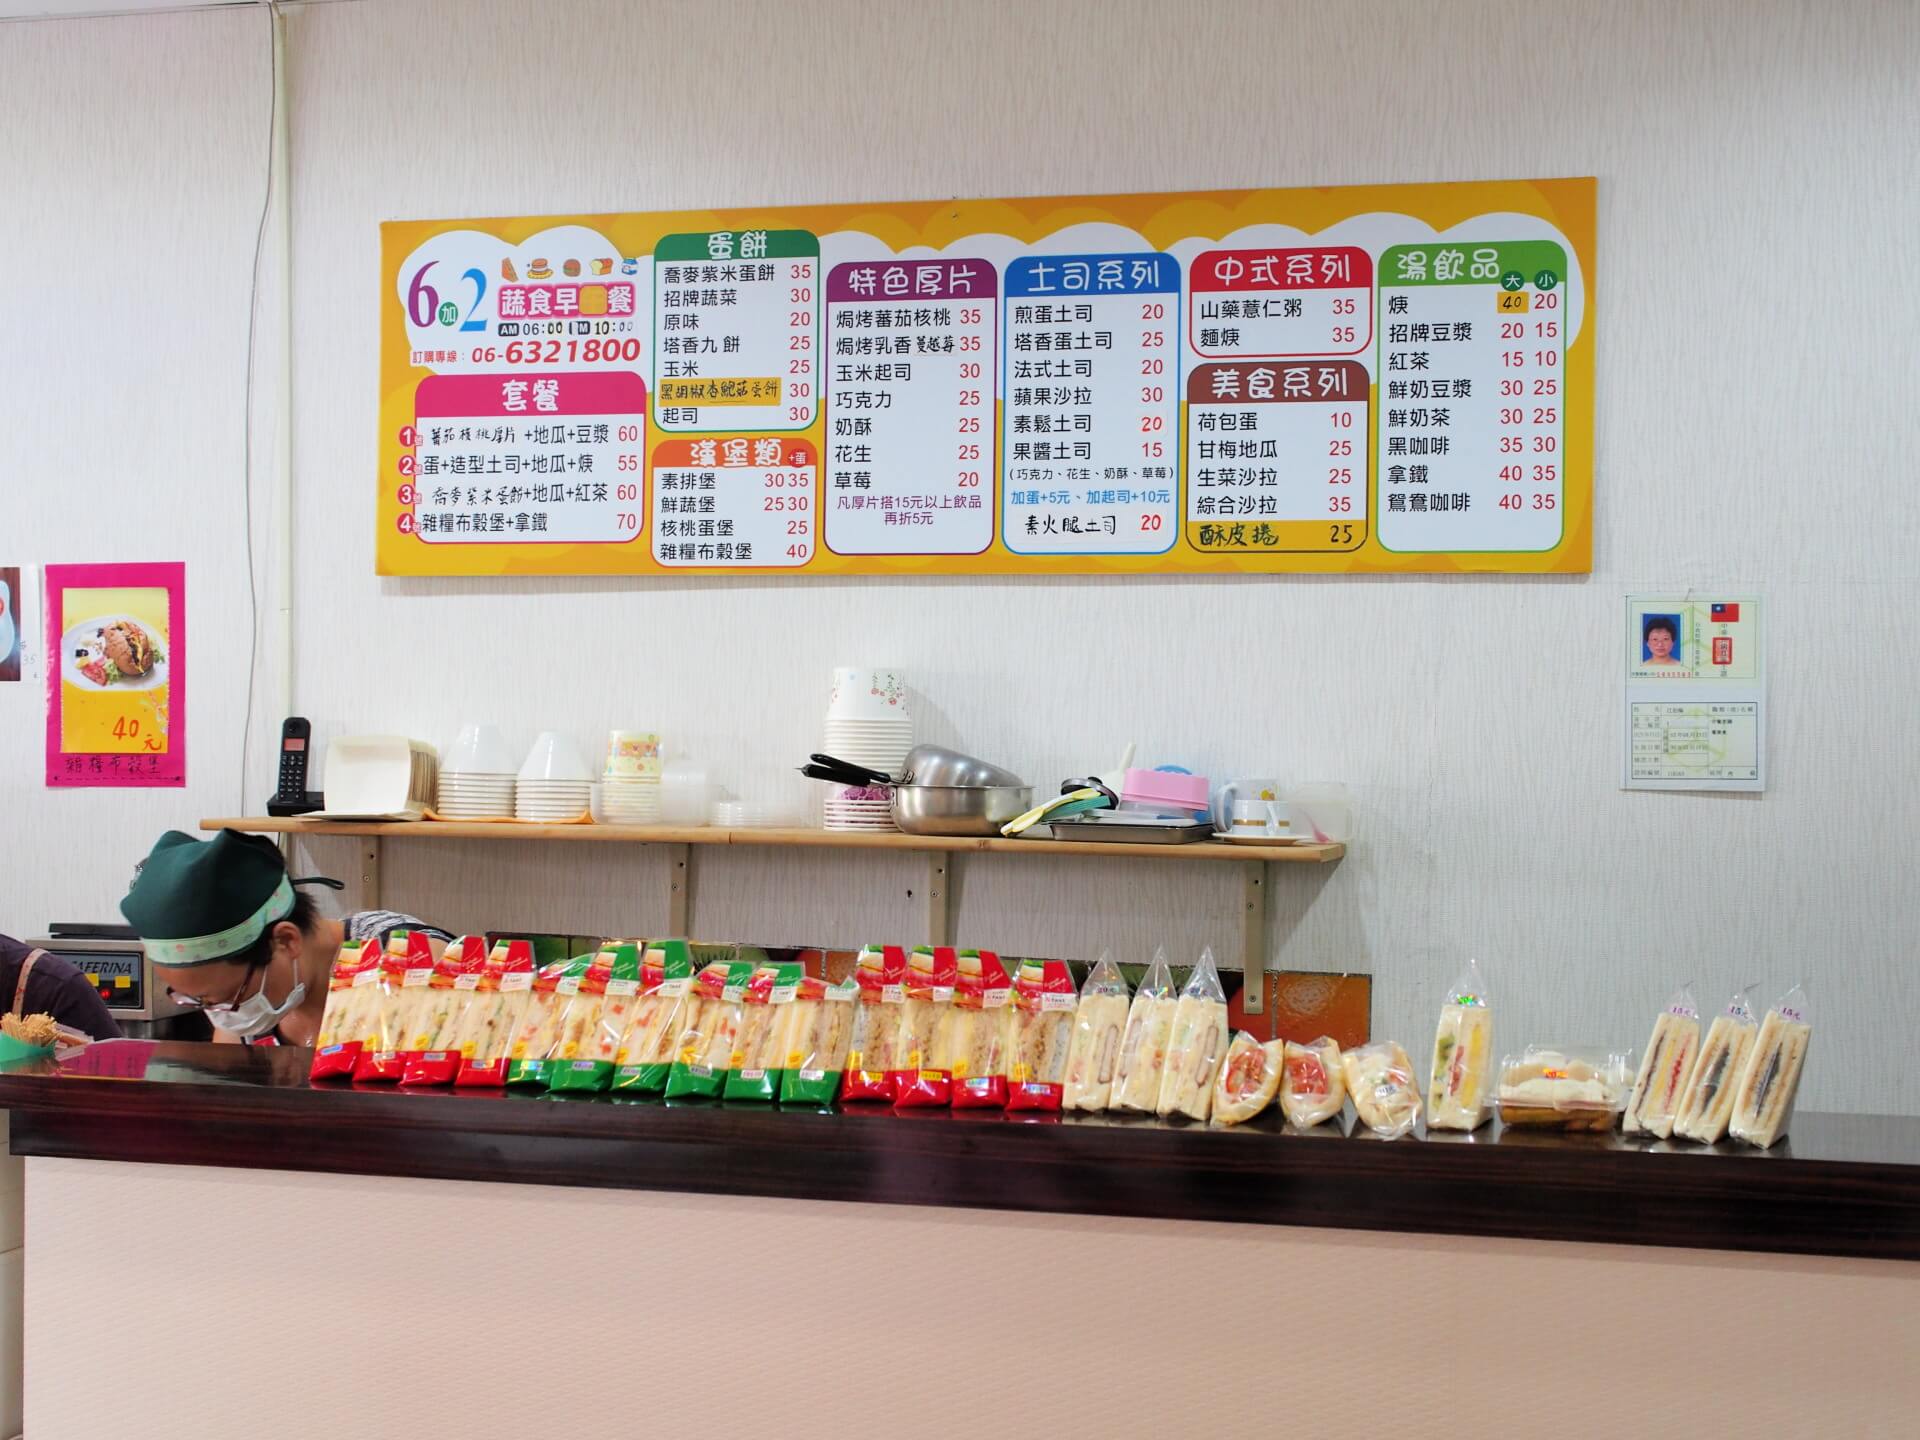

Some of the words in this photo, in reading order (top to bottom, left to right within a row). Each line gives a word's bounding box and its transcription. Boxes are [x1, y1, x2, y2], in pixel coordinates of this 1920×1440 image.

[707, 231, 767, 260] 蛋餅
[791, 265, 811, 279] 35
[1214, 254, 1350, 286] 中式系列
[1397, 248, 1500, 281] 湯飲品
[848, 265, 977, 296] 特色厚片
[1027, 260, 1159, 292] 土司系列
[1506, 274, 1520, 288] 大
[1539, 273, 1553, 287] 小
[501, 285, 632, 316] 蔬食早餐
[664, 289, 737, 307] 招牌蔬菜
[790, 288, 810, 302] 30
[1503, 296, 1522, 309] 40
[1534, 293, 1557, 309] 20
[836, 308, 950, 329] 焗烤蕃茄核桃
[960, 309, 981, 324] 35
[1014, 304, 1093, 324] 煎蛋土司
[1142, 304, 1164, 319] 20
[1201, 298, 1302, 320] 山藥薏仁粥
[1333, 299, 1355, 314] 35
[499, 323, 519, 336] AM
[523, 322, 563, 336] 06:00
[664, 313, 699, 330] 原味
[790, 312, 810, 326] 20
[1014, 331, 1112, 351] 塔香蛋土司
[1142, 332, 1164, 347] 25
[1332, 327, 1354, 343] 35
[1389, 322, 1472, 343] 招牌豆漿
[1501, 322, 1524, 339] 20
[1535, 322, 1557, 338] 15
[472, 338, 640, 364] 06-6321800
[790, 336, 810, 350] 25
[960, 336, 981, 351] 35
[663, 360, 699, 377] 玉米
[790, 359, 810, 374] 25
[1014, 359, 1092, 379] 法式土司
[1142, 359, 1163, 375] 20
[1389, 351, 1429, 371] 紅茶
[1502, 351, 1524, 367] 15
[1535, 350, 1556, 366] 10
[836, 363, 911, 382] 玉米起司
[959, 363, 980, 378] 30
[789, 383, 810, 397] 30
[1212, 367, 1347, 399] 美食系列
[1388, 379, 1471, 400] 鮮奶豆漿
[1501, 380, 1523, 396] 30
[1534, 379, 1556, 395] 25
[502, 379, 559, 411] 套餐
[835, 390, 891, 408] 巧克力
[959, 391, 980, 405] 25
[1014, 386, 1092, 406] 蘋果沙拉
[1141, 387, 1163, 402] 30
[662, 408, 698, 424] 起司
[789, 407, 809, 421] 30
[1013, 414, 1091, 433] 素鬆土司
[1141, 416, 1162, 432] 20
[1198, 412, 1258, 431] 荷包蛋
[1331, 412, 1351, 428] 10
[1388, 407, 1450, 428] 鮮奶茶
[1500, 408, 1523, 424] 30
[1533, 408, 1556, 424] 25
[618, 425, 638, 441] 60
[835, 417, 872, 436] 奶酥
[959, 418, 980, 433] 25
[690, 438, 782, 466] 漢堡類
[835, 444, 871, 463] 花生
[958, 445, 979, 460] 25
[1013, 441, 1091, 460] 果醬土司
[1142, 442, 1163, 457] 15
[1198, 440, 1278, 460] 甘梅地瓜
[1329, 440, 1351, 456] 25
[1388, 436, 1450, 456] 黑咖啡
[1500, 436, 1523, 453] 35
[1533, 436, 1556, 452] 30
[618, 455, 638, 471] 55
[661, 472, 716, 490] 素排堡
[764, 473, 784, 488] 30
[788, 473, 808, 487] 35
[834, 471, 871, 490] 草莓
[958, 472, 979, 487] 20
[1197, 468, 1278, 487] 生菜沙拉
[1329, 468, 1351, 484] 25
[1388, 464, 1428, 484] 拿鐵
[1499, 465, 1522, 481] 40
[1532, 465, 1556, 481] 35
[617, 484, 637, 500] 60
[661, 496, 715, 514] 鮮蔬堡
[764, 497, 784, 511] 25
[788, 497, 808, 511] 30
[837, 495, 982, 510] 凡厚片搭15元以上飲品
[1197, 495, 1278, 515] 綜合沙拉
[1329, 496, 1351, 512] 35
[1388, 492, 1470, 513] 鴛鴦咖啡
[1498, 494, 1522, 510] 40
[1532, 494, 1555, 510] 35
[422, 512, 548, 533] 雜糧布穀堡+拿鐵
[617, 514, 637, 530] 70
[660, 519, 734, 537] 核桃蛋堡
[787, 520, 808, 534] 25
[884, 512, 933, 525] 再折5元
[1141, 514, 1161, 530] 20
[1330, 525, 1353, 543] 25
[660, 542, 752, 560] 雜糧布穀堡
[786, 544, 807, 558] 40
[112, 716, 139, 740] 40
